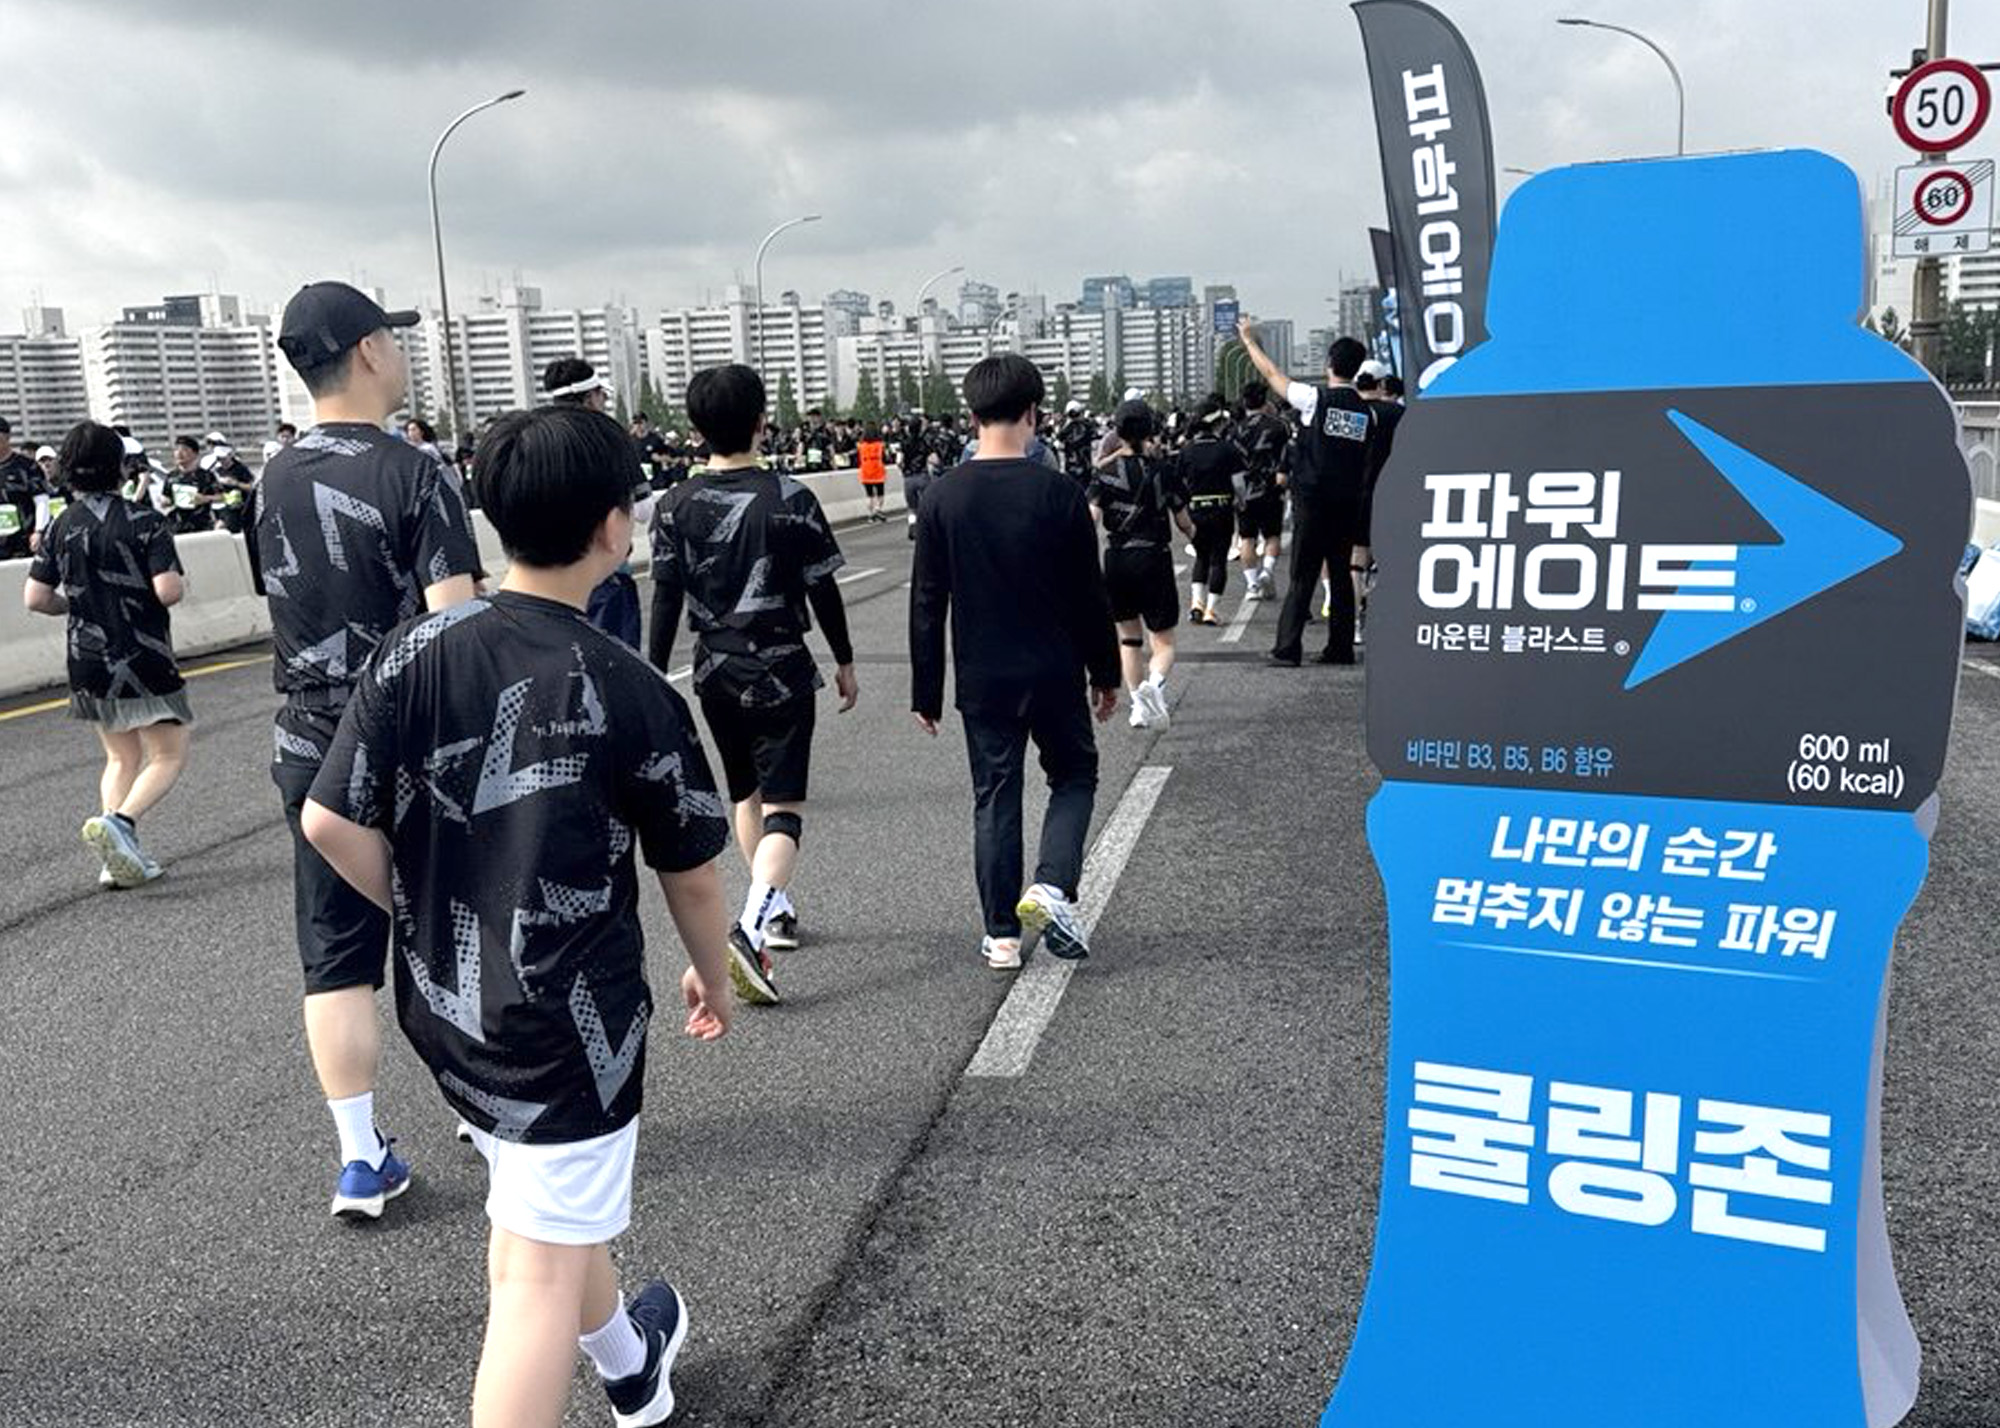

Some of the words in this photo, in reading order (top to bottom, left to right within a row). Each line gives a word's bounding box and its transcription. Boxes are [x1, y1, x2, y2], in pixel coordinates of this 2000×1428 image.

[1916, 84, 1965, 129] 50
[1926, 186, 1959, 209] 60
[1421, 471, 1621, 538] 파워
[1417, 623, 1490, 651] 마운틴
[1406, 738, 1461, 769] 비타민
[1467, 743, 1497, 773] B3,
[1503, 745, 1534, 775] B5,
[1541, 747, 1568, 774] B6
[1574, 746, 1614, 778] 함유
[1799, 733, 1849, 762] 600
[1859, 738, 1890, 763] ml
[1787, 759, 1830, 793] (60
[1840, 765, 1904, 799] kcal)
[1489, 815, 1650, 871] 나만의
[1661, 826, 1778, 882] 순간
[1431, 877, 1584, 937] 멈추지
[1597, 891, 1705, 948] 않는
[1718, 901, 1837, 960] 파워
[1408, 1060, 1833, 1253] 쿨링존
